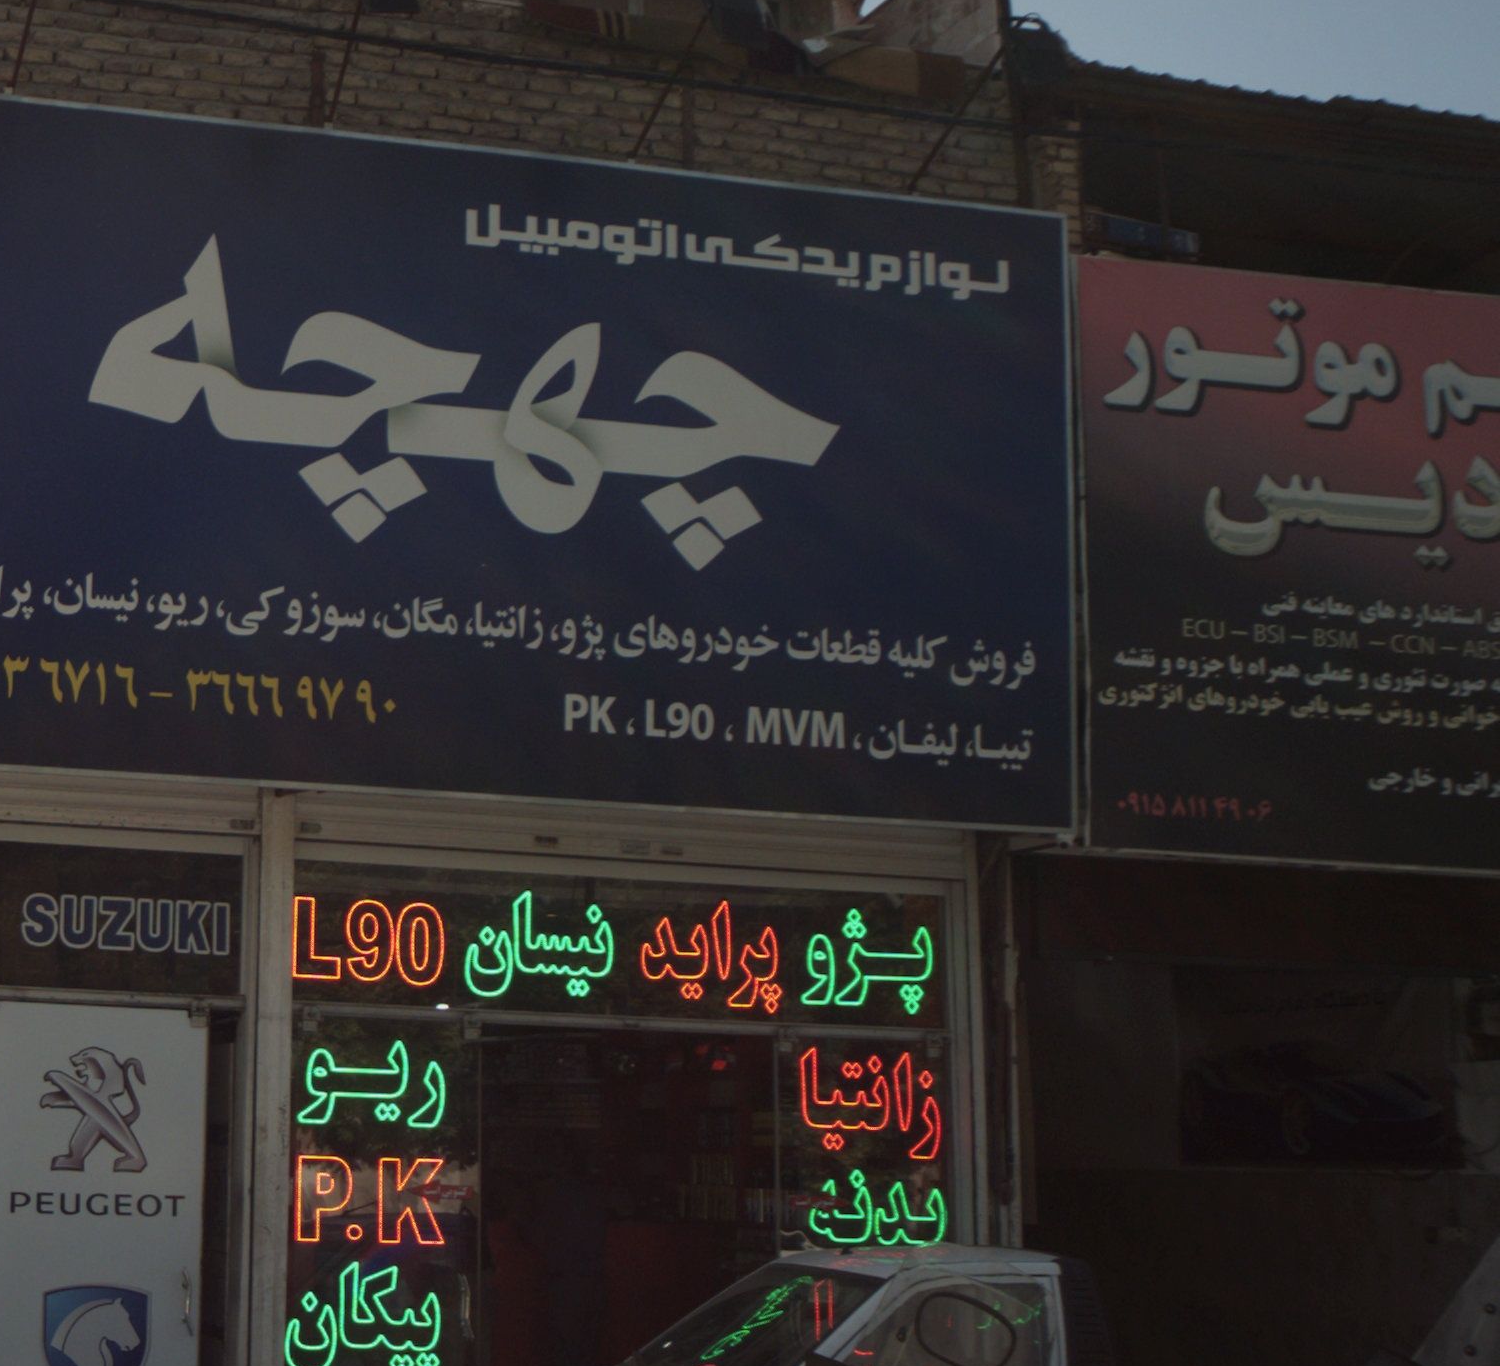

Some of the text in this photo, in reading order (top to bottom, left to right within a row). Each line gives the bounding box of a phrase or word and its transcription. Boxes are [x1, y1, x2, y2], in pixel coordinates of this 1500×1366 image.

[465, 203, 1010, 300] لوازم یدکی اتومبیل
[1103, 297, 1398, 427] موتور
[1261, 591, 1298, 618] فنی
[1303, 596, 1355, 620] معاینه
[1358, 599, 1396, 623] های
[1399, 603, 1483, 629] استاندارد
[613, 614, 780, 670] خودروهای
[786, 627, 883, 665] قطعات
[1182, 618, 1225, 640] ECU
[1253, 623, 1286, 644] BSI
[1312, 628, 1358, 650] BSM
[1390, 634, 1434, 654] CCN
[887, 634, 946, 679] کلیه
[950, 640, 1037, 690] فروش
[1113, 647, 1156, 668] نقشه
[1160, 657, 1172, 676] و
[1228, 653, 1243, 680] با
[1247, 657, 1301, 683] همراه
[1304, 661, 1353, 686] عملی
[1357, 671, 1369, 690] و
[1429, 673, 1487, 697] صورت
[563, 693, 616, 733] PK
[1186, 685, 1285, 717] خودروهای
[1334, 702, 1373, 721] عیب
[1377, 699, 1423, 726] روش
[1367, 767, 1436, 793] خارجی
[21, 892, 231, 956] SUZUKI
[292, 896, 446, 987] L90
[464, 889, 934, 1015] پژو پراید نیسان
[298, 1039, 445, 1128] ریو
[800, 1046, 941, 1159] زانتیا
[10, 1190, 186, 1218] PEUGEOT
[296, 1155, 445, 1246] P.K
